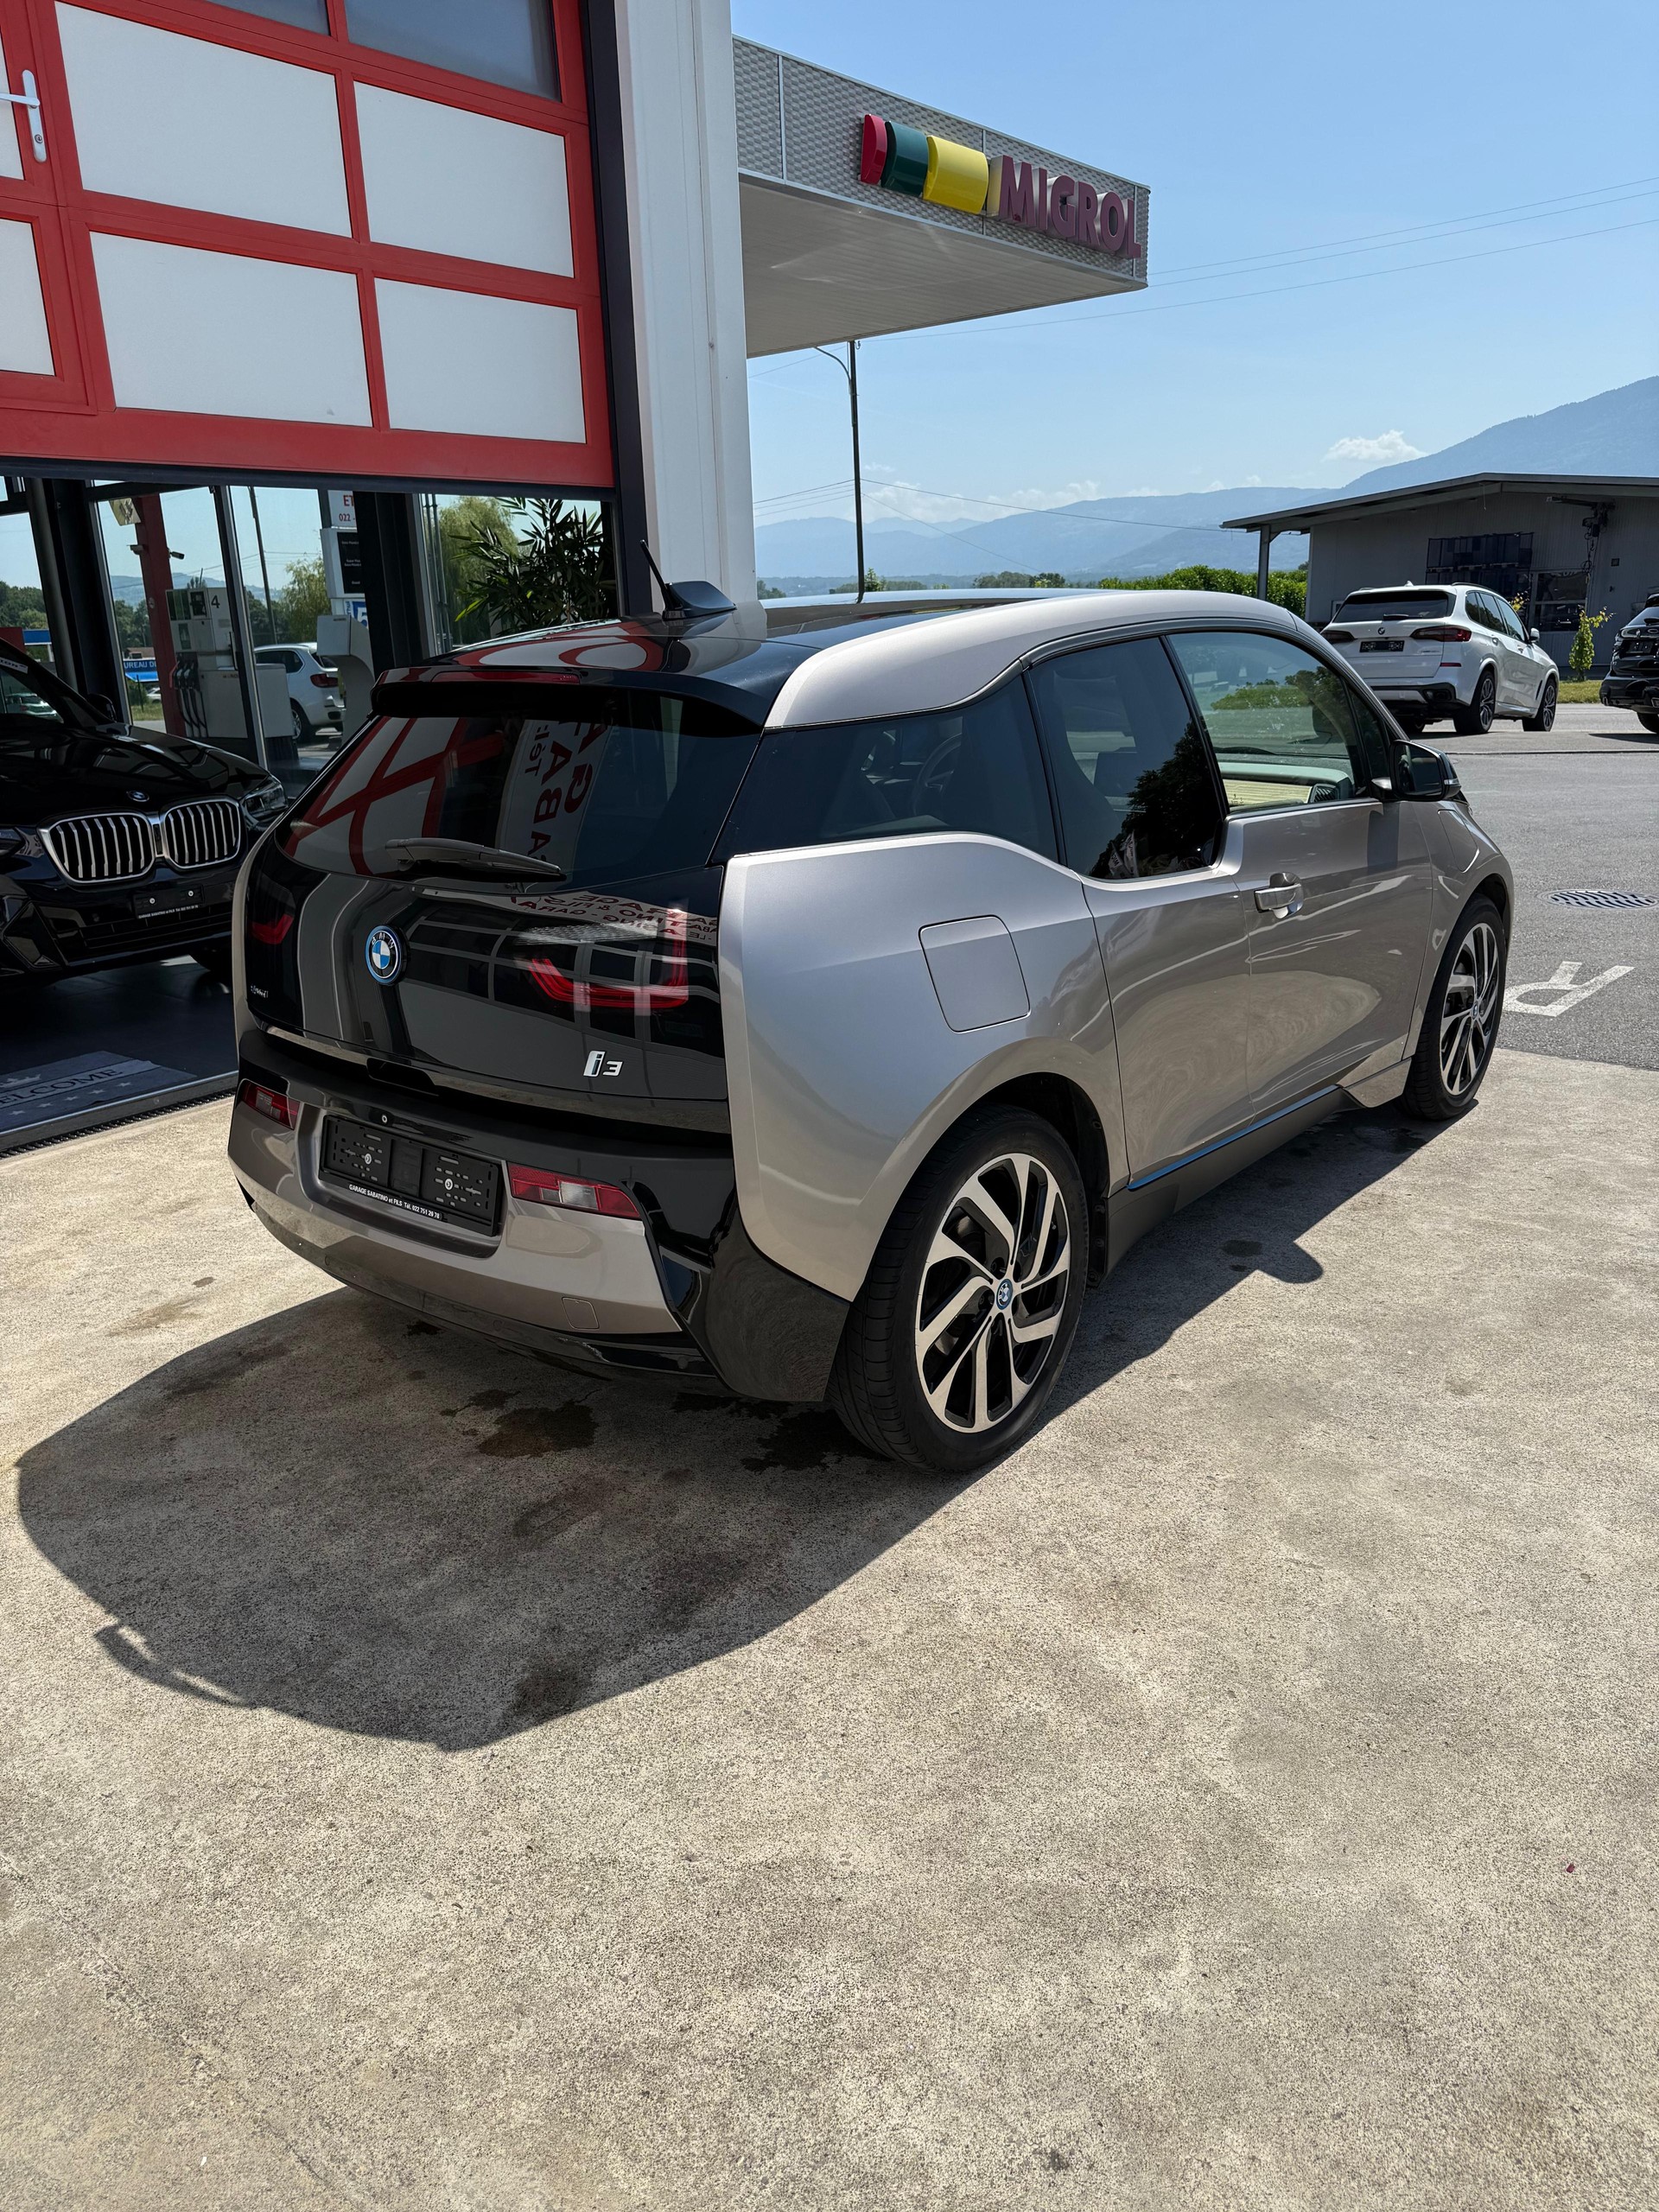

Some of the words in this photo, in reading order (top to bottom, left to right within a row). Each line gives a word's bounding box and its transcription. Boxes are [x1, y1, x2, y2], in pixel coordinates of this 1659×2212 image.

[997, 156, 1141, 258] MIGROL
[211, 594, 220, 608] 4
[372, 931, 395, 949] BMW
[582, 1051, 623, 1077] i3
[349, 1184, 366, 1195] GARAGE
